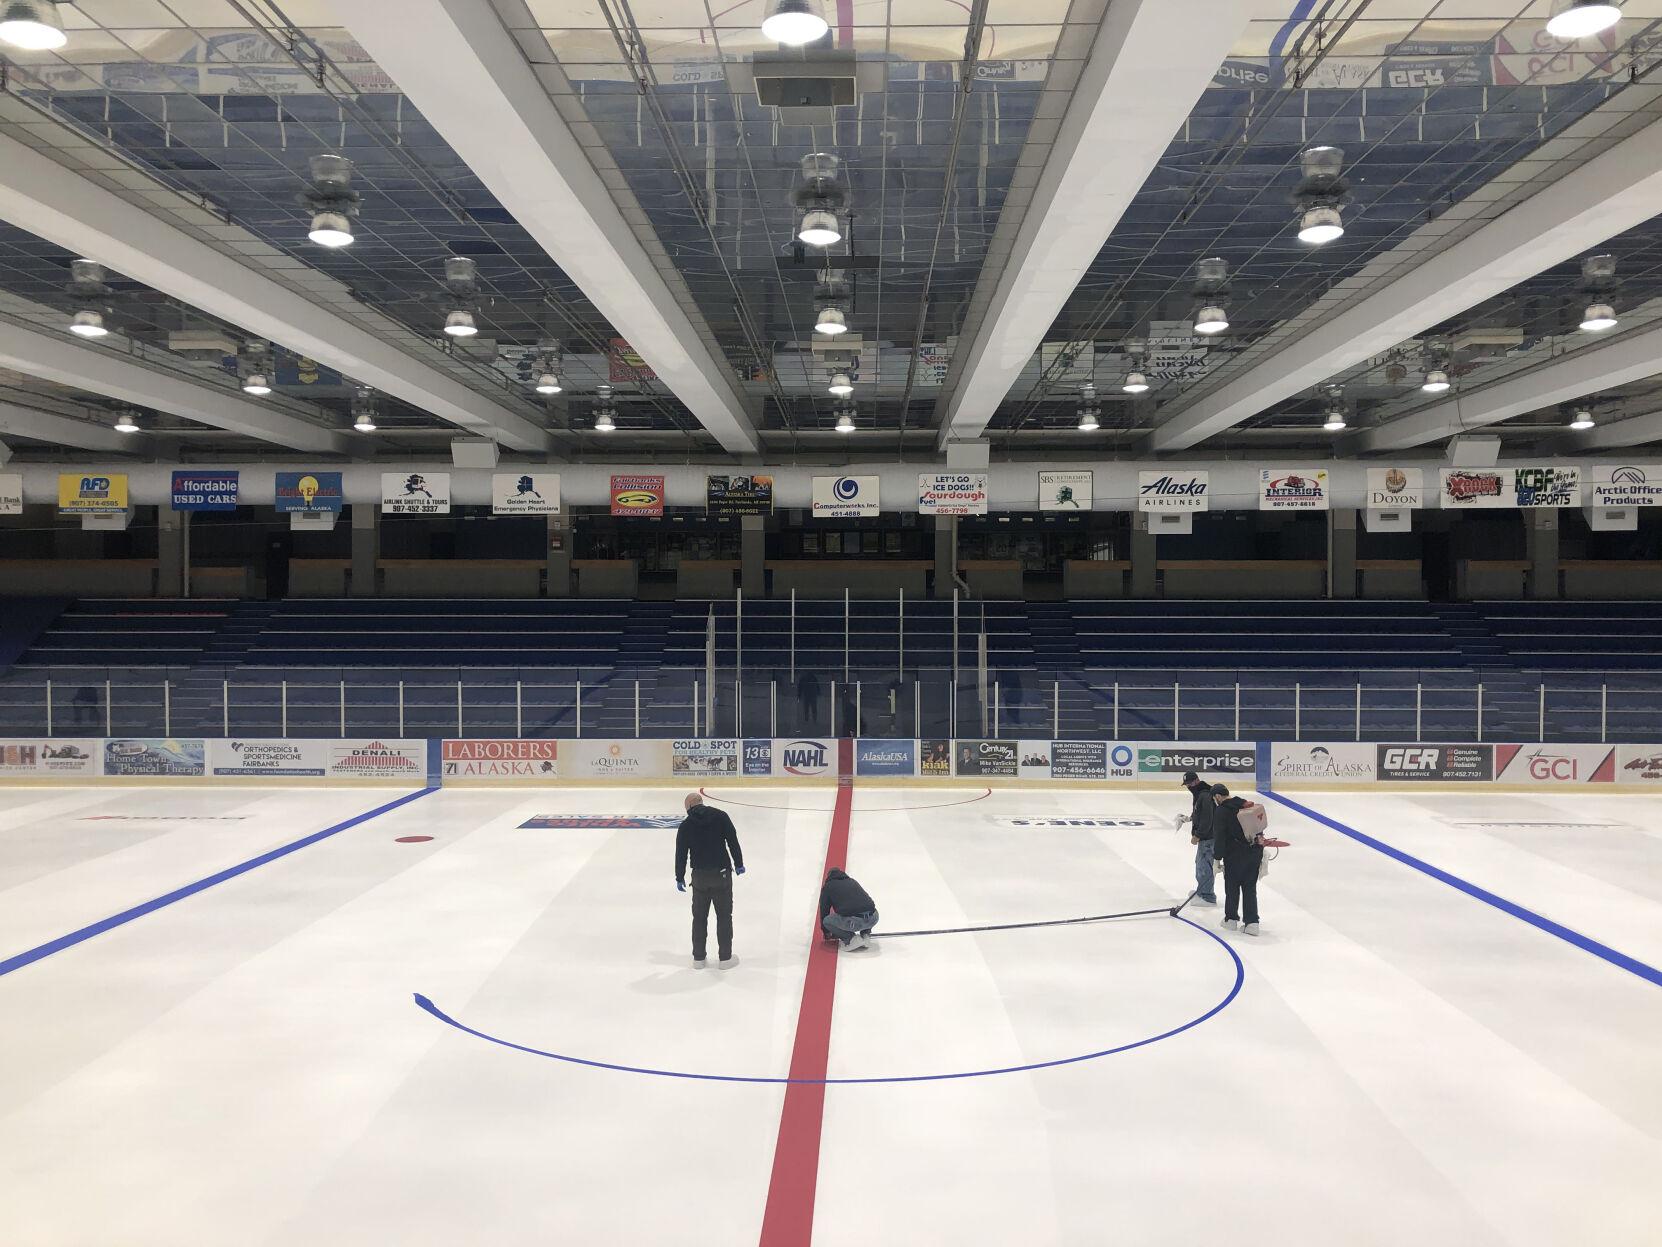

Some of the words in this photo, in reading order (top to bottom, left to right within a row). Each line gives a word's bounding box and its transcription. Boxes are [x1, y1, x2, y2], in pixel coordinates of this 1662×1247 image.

[174, 479, 237, 491] Affordable
[1141, 476, 1207, 496] Alaska
[1515, 468, 1554, 492] KCBF
[1265, 488, 1323, 496] INTERIOR
[1595, 486, 1628, 494] Arctic
[1630, 486, 1662, 494] Office
[174, 495, 204, 504] USED
[208, 495, 237, 504] CARS
[923, 491, 985, 502] Sourdough
[1373, 492, 1417, 504] DOYON
[1535, 493, 1571, 505] SPORTS
[1603, 496, 1653, 504] Products
[448, 742, 552, 758] LABORERS
[673, 741, 701, 749] COLD
[710, 741, 737, 749] SPOT
[979, 743, 1008, 754] Century
[1004, 750, 1013, 759] 21
[106, 753, 136, 762] Home
[141, 753, 166, 762] Town
[745, 747, 758, 758] 13
[783, 749, 828, 766] NAHL
[861, 752, 908, 761] AlaskaUSA
[598, 758, 638, 768] QUINTA
[1145, 754, 1254, 770] enterprise
[1383, 749, 1440, 769] GCR
[121, 763, 159, 774] Physical
[164, 763, 204, 775] Therapy
[464, 762, 535, 775] ALASKA
[1325, 757, 1372, 776] ALASKA
[1529, 758, 1577, 780] GCI
